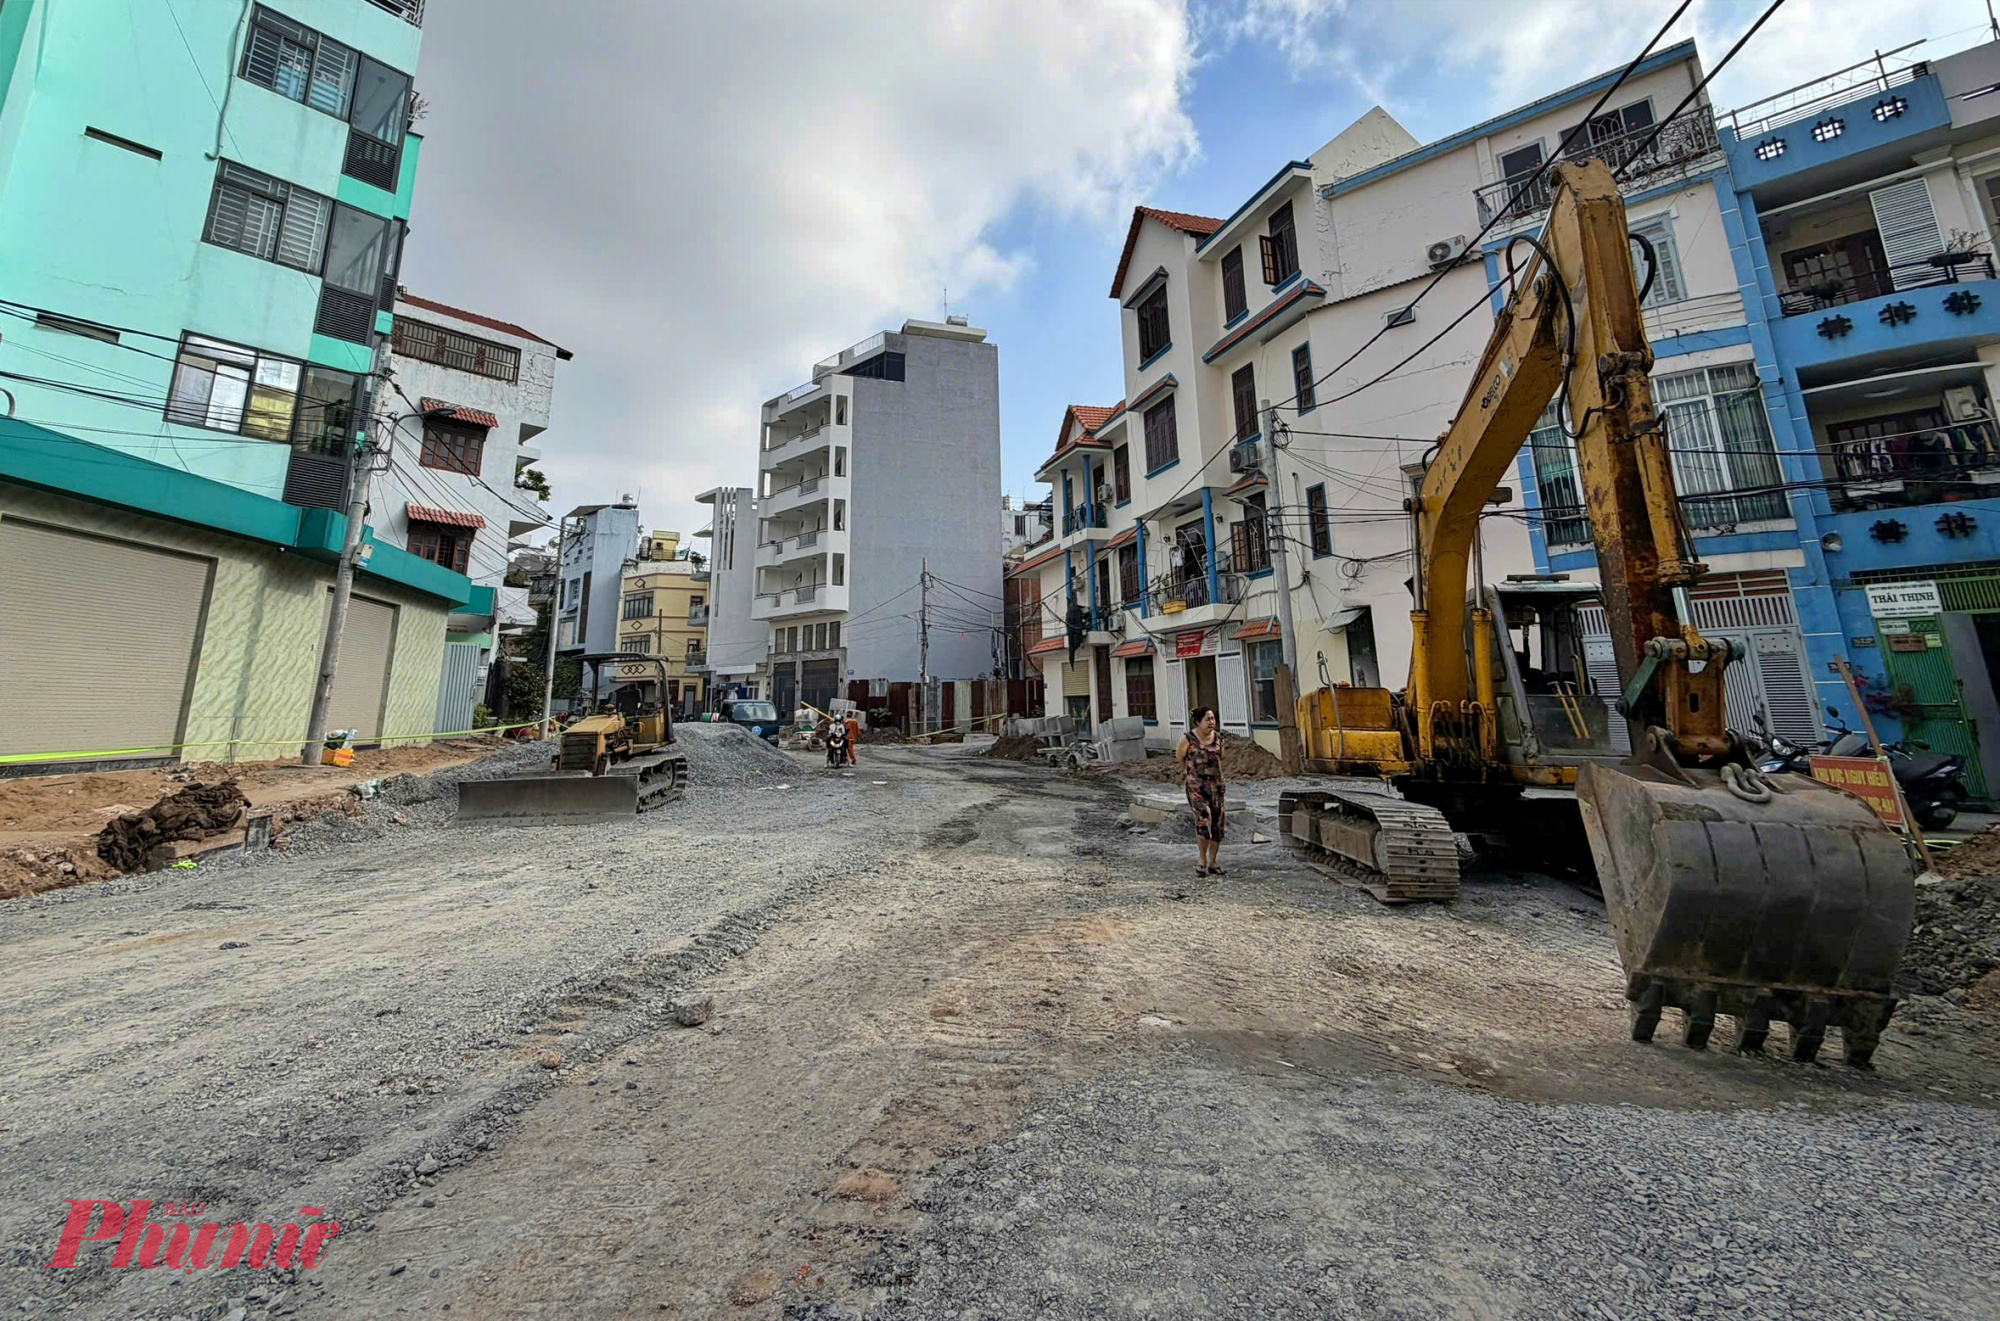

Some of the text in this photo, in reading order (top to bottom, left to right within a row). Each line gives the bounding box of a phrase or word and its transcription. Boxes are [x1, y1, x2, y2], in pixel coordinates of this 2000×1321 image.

[1871, 591, 1935, 604] THÁI THỊNH
[1844, 768, 1867, 785] NGUY
